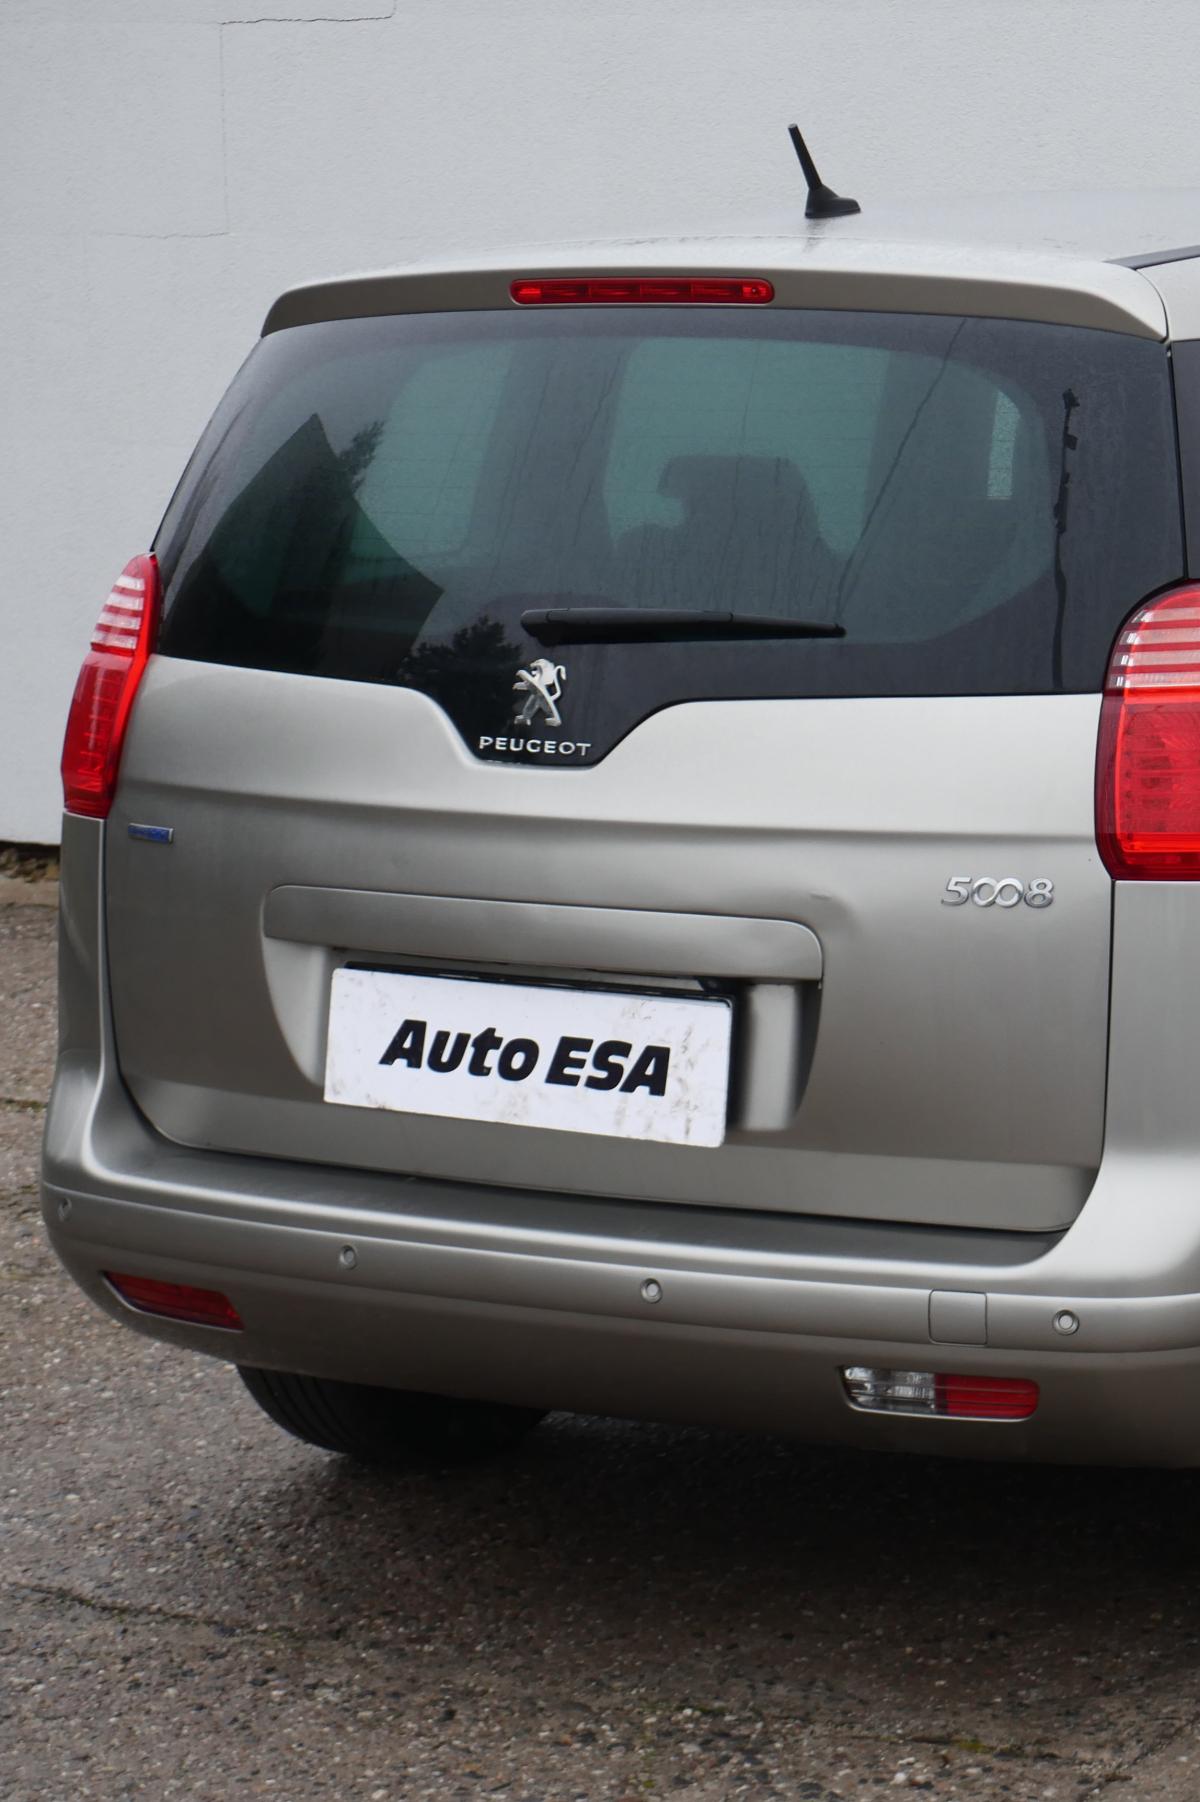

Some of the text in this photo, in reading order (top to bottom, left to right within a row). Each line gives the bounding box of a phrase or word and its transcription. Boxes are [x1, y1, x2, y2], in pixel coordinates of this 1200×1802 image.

[479, 736, 592, 756] PEUGEOT
[940, 876, 1054, 908] 5008
[379, 1019, 671, 1097] Auto ESA
